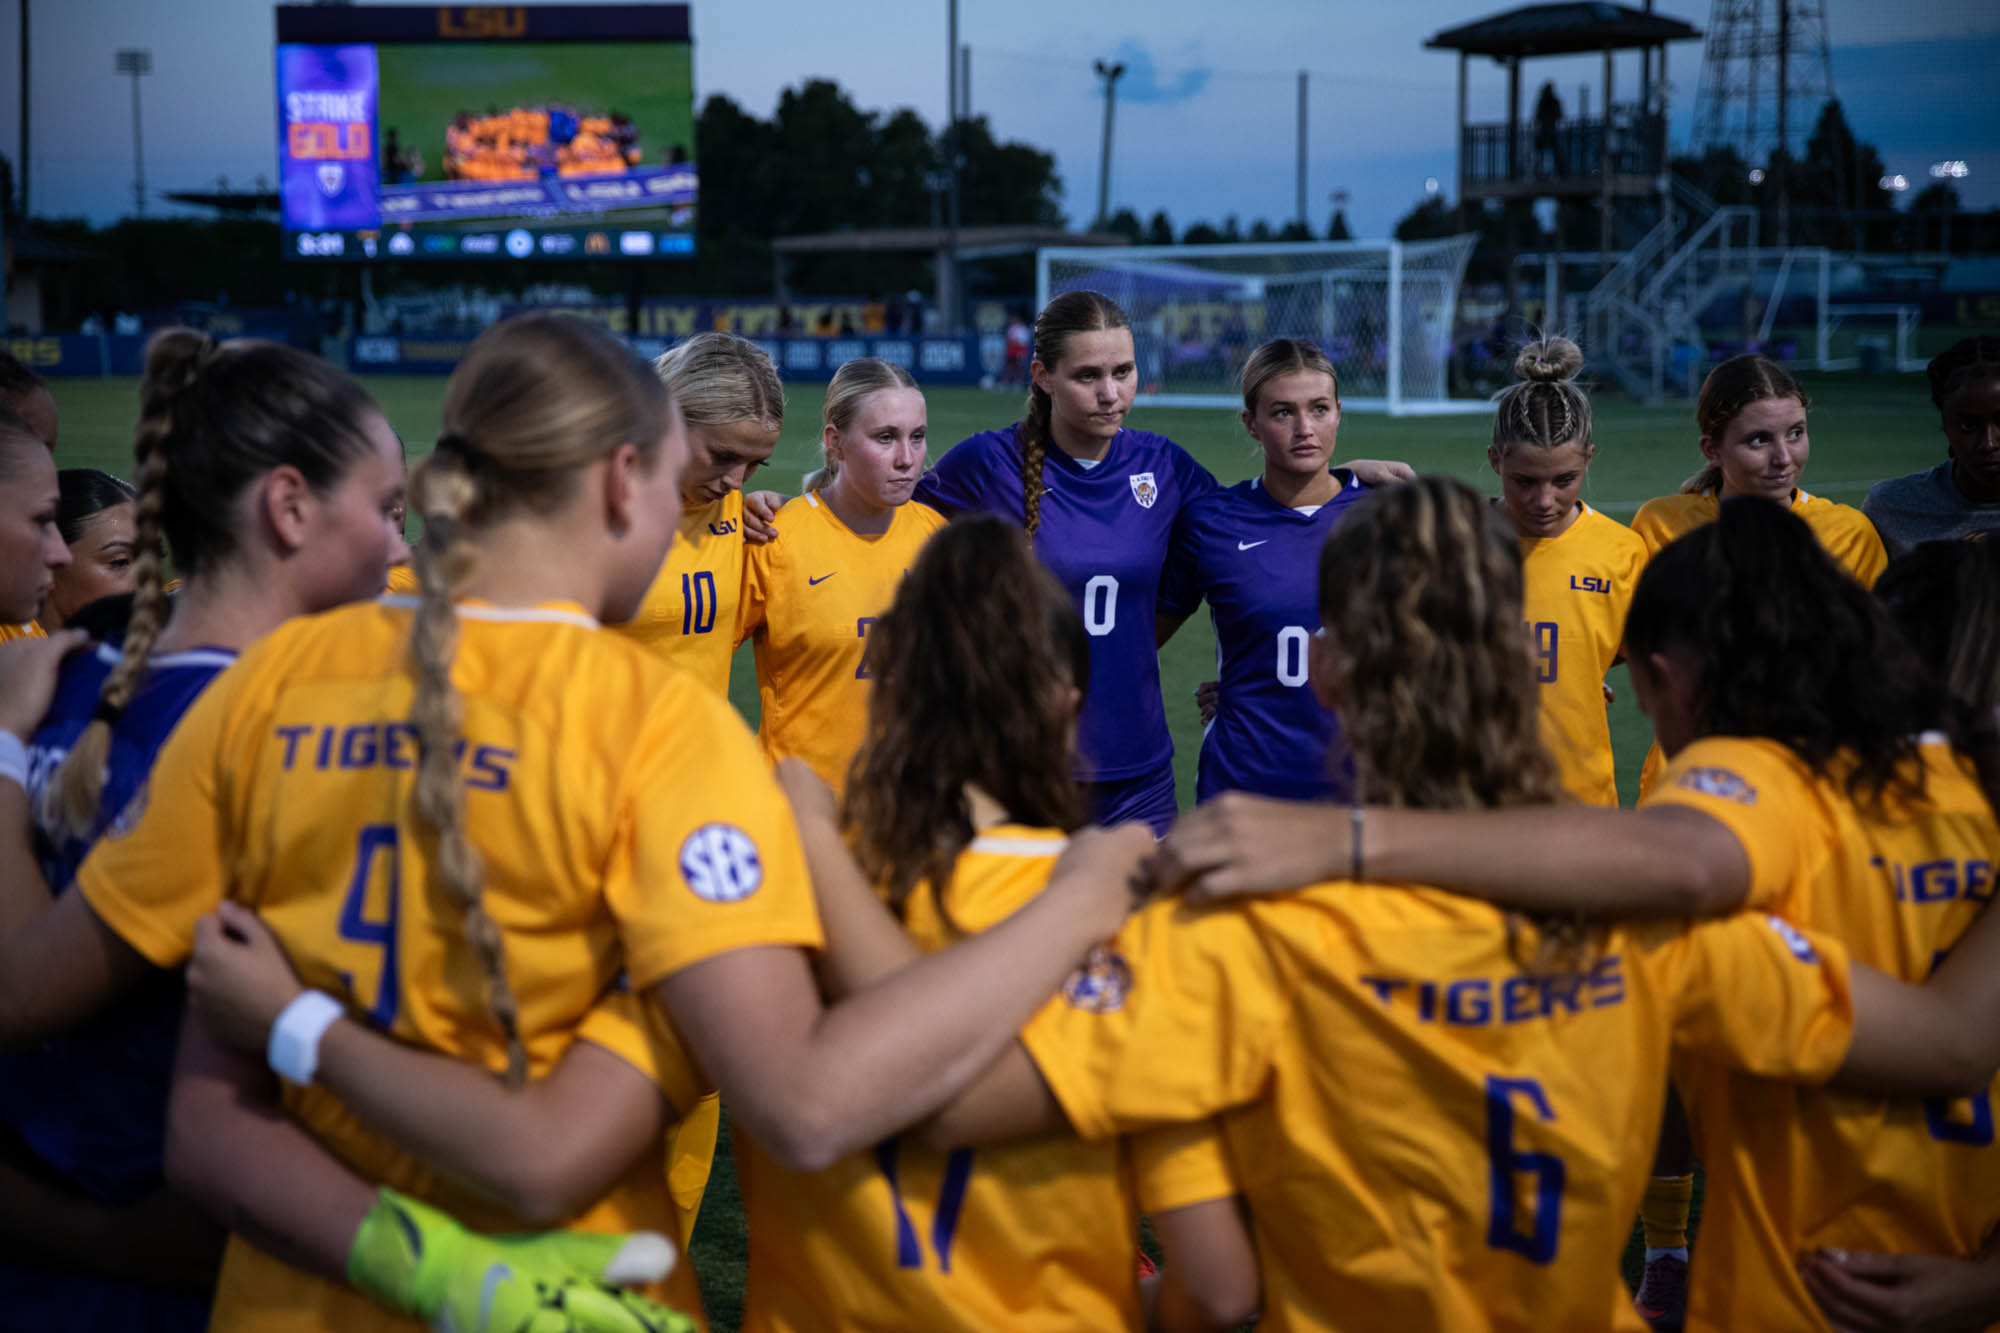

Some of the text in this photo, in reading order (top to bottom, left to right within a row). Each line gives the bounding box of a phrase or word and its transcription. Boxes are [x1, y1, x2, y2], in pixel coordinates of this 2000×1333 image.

[437, 6, 527, 38] LSU
[288, 122, 369, 159] GOLD
[708, 517, 738, 536] LSU
[682, 570, 717, 635] 10
[1084, 575, 1119, 636] 0
[1570, 575, 1611, 594] LSU
[275, 722, 517, 792] TIGES
[682, 827, 762, 900] SEC
[338, 824, 400, 1029] 9
[1486, 1073, 1565, 1265] 6
